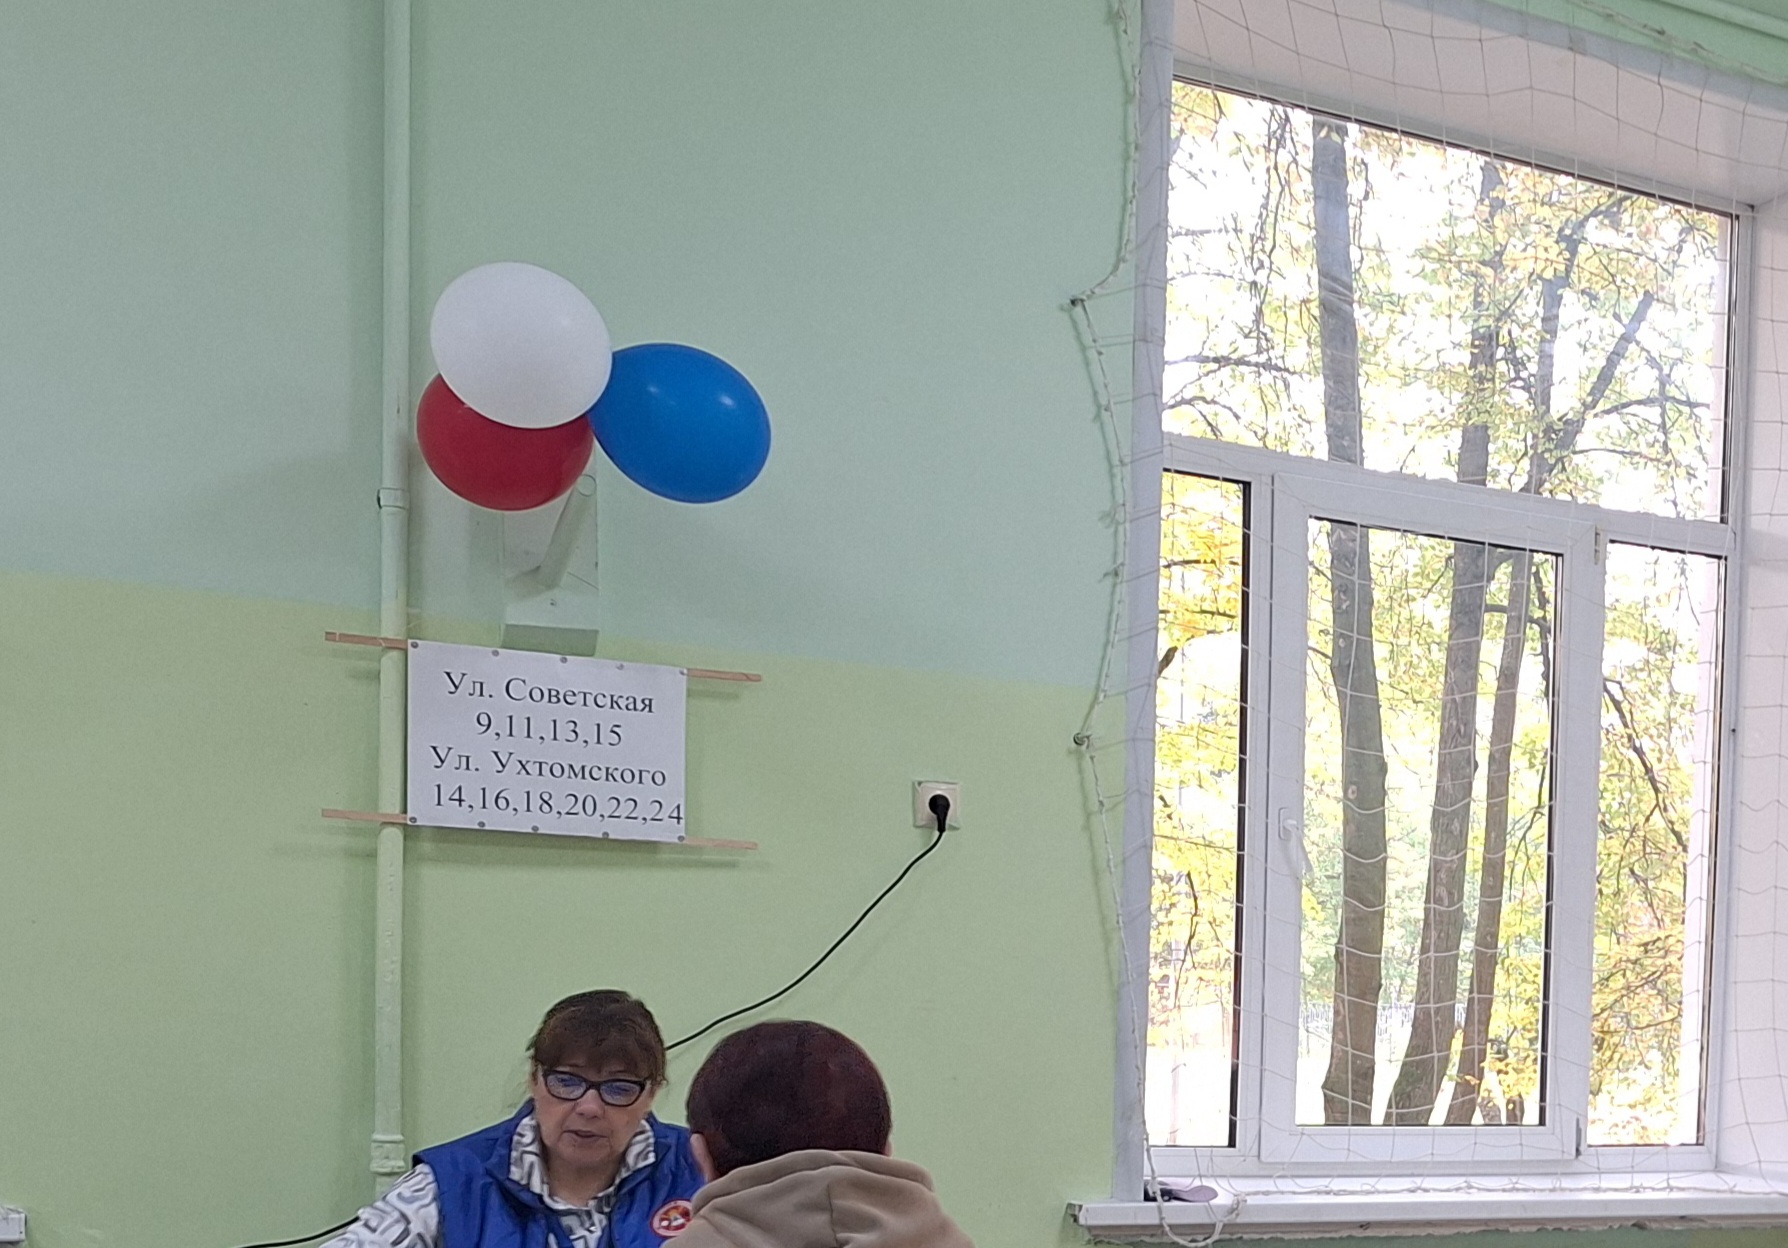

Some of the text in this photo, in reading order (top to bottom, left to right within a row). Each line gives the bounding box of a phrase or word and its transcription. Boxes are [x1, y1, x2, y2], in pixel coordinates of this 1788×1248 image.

[443, 670, 654, 713] Ул. Советская
[475, 711, 622, 747] 9,11,13,15
[430, 745, 666, 786] Ул. Ухтомского
[433, 783, 683, 825] 14,16,18,20,22,24
